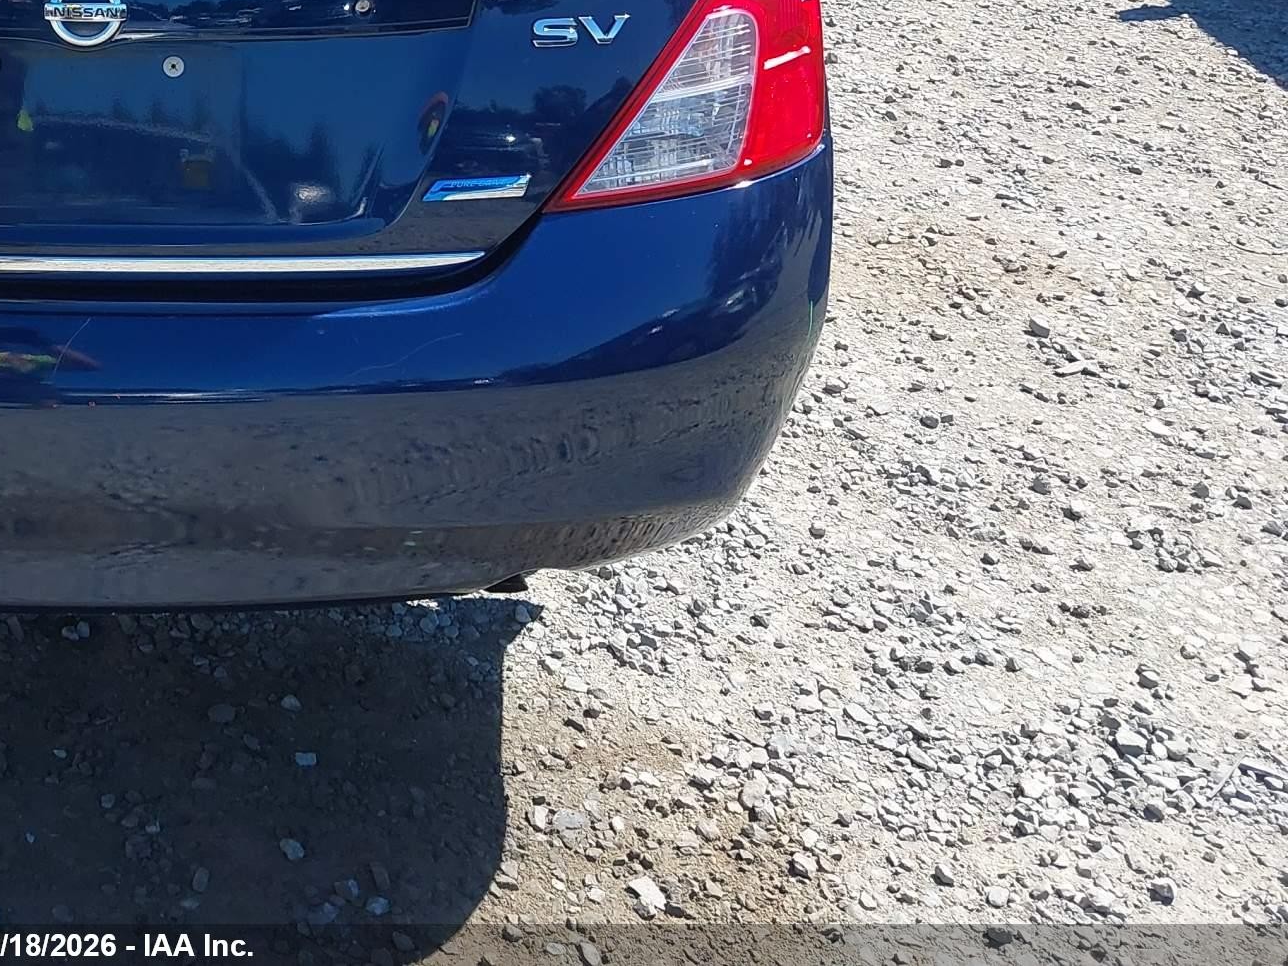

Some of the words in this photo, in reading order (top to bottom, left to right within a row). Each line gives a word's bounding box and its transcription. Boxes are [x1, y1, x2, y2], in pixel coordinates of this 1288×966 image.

[53, 6, 118, 19] NISSAN
[532, 14, 631, 48] SV
[450, 179, 475, 188] PURE
